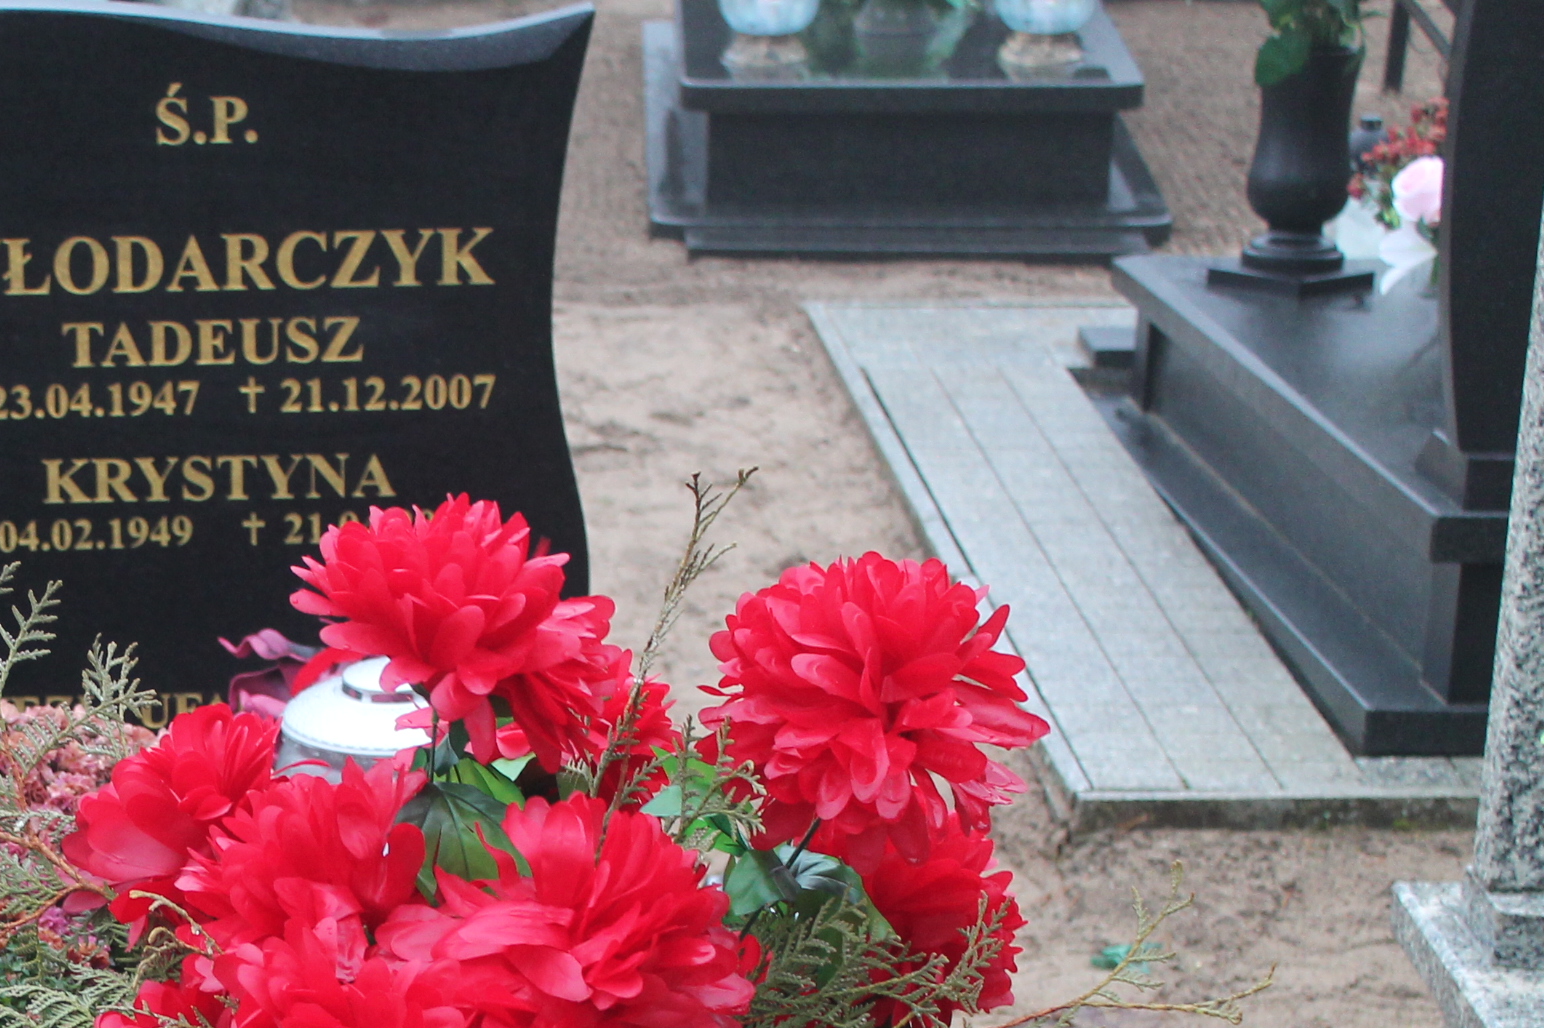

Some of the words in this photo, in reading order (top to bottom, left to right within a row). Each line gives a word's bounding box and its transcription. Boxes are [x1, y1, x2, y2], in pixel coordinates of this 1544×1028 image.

[156, 82, 259, 146] Ś.P.
[61, 315, 365, 368] TADEUSZ
[279, 373, 497, 413] 21.12.2007
[41, 452, 397, 505] KRYSTYNA
